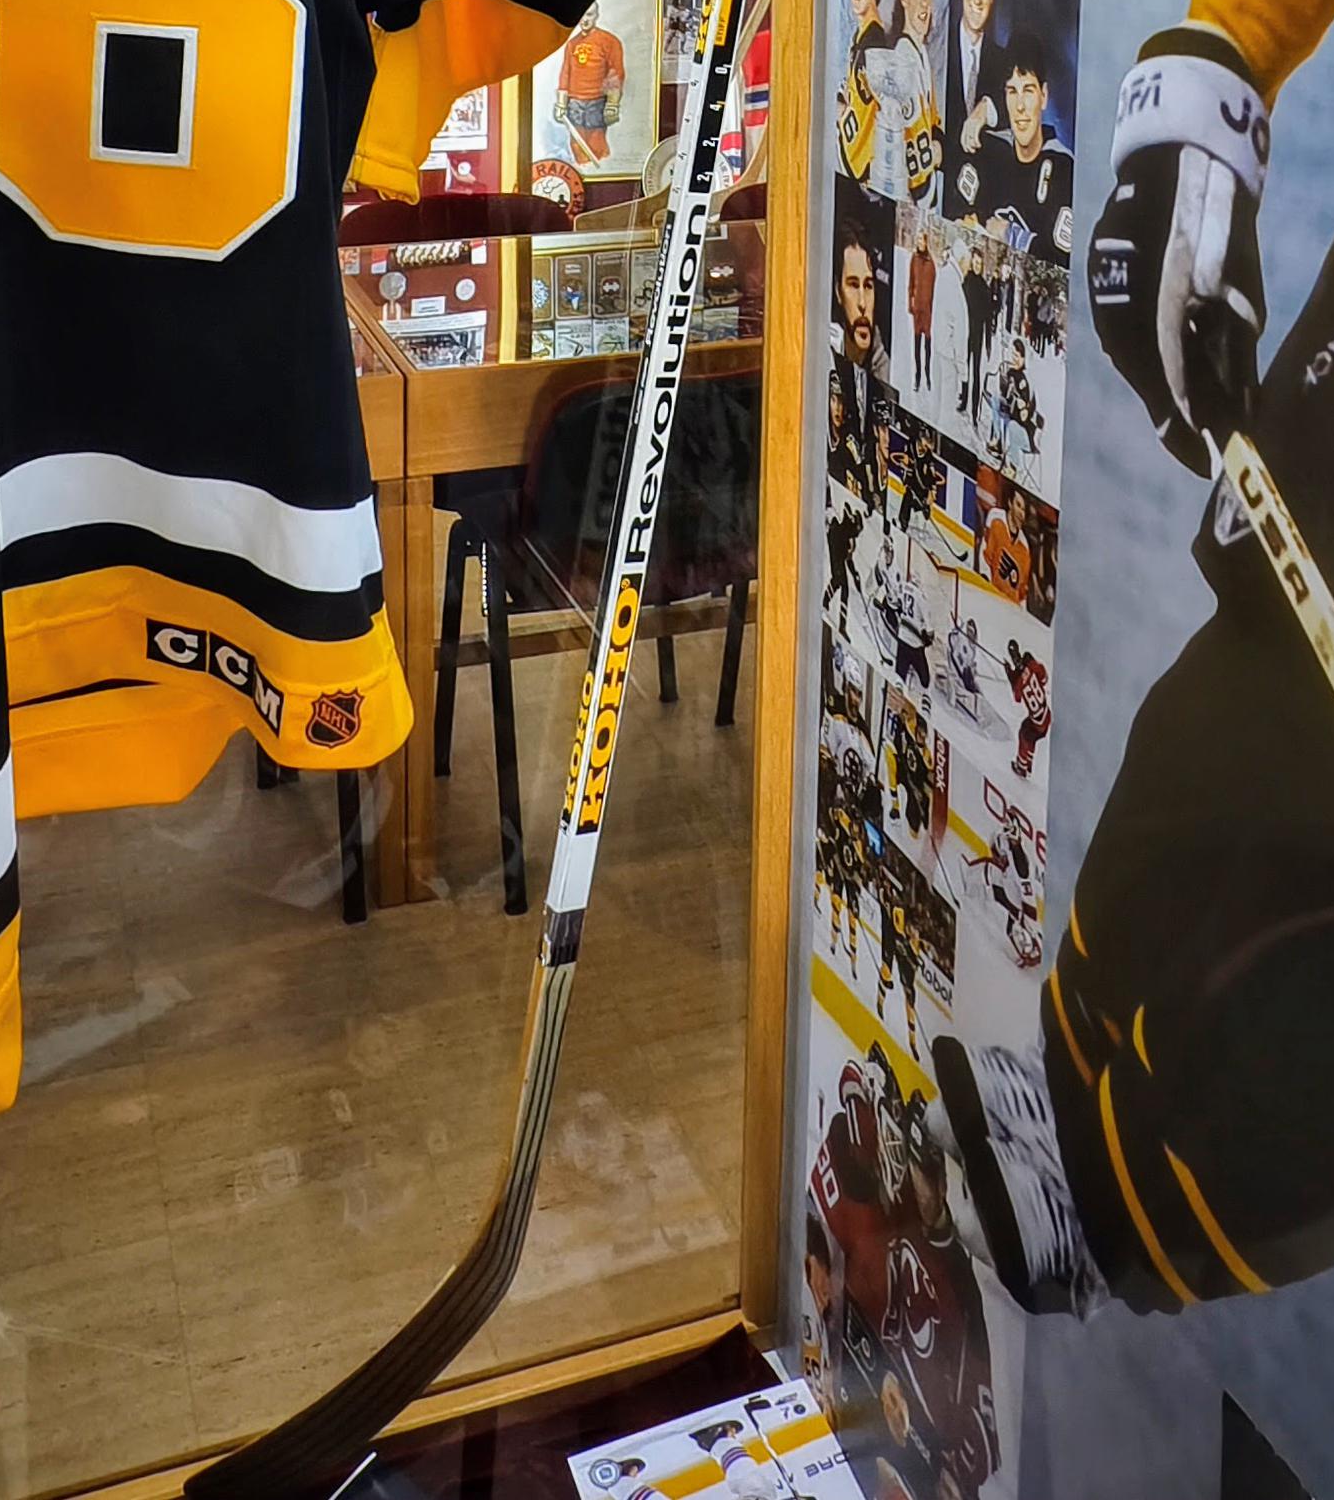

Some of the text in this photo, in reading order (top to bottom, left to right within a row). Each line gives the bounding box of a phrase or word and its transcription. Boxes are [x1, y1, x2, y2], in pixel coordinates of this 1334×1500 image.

[904, 130, 934, 177] 68
[624, 204, 707, 564] Revolution
[153, 625, 282, 735] CCM
[579, 587, 639, 828] KOHO
[1022, 671, 1045, 712] 68
[318, 699, 353, 737] NHL
[816, 1142, 840, 1209] 30
